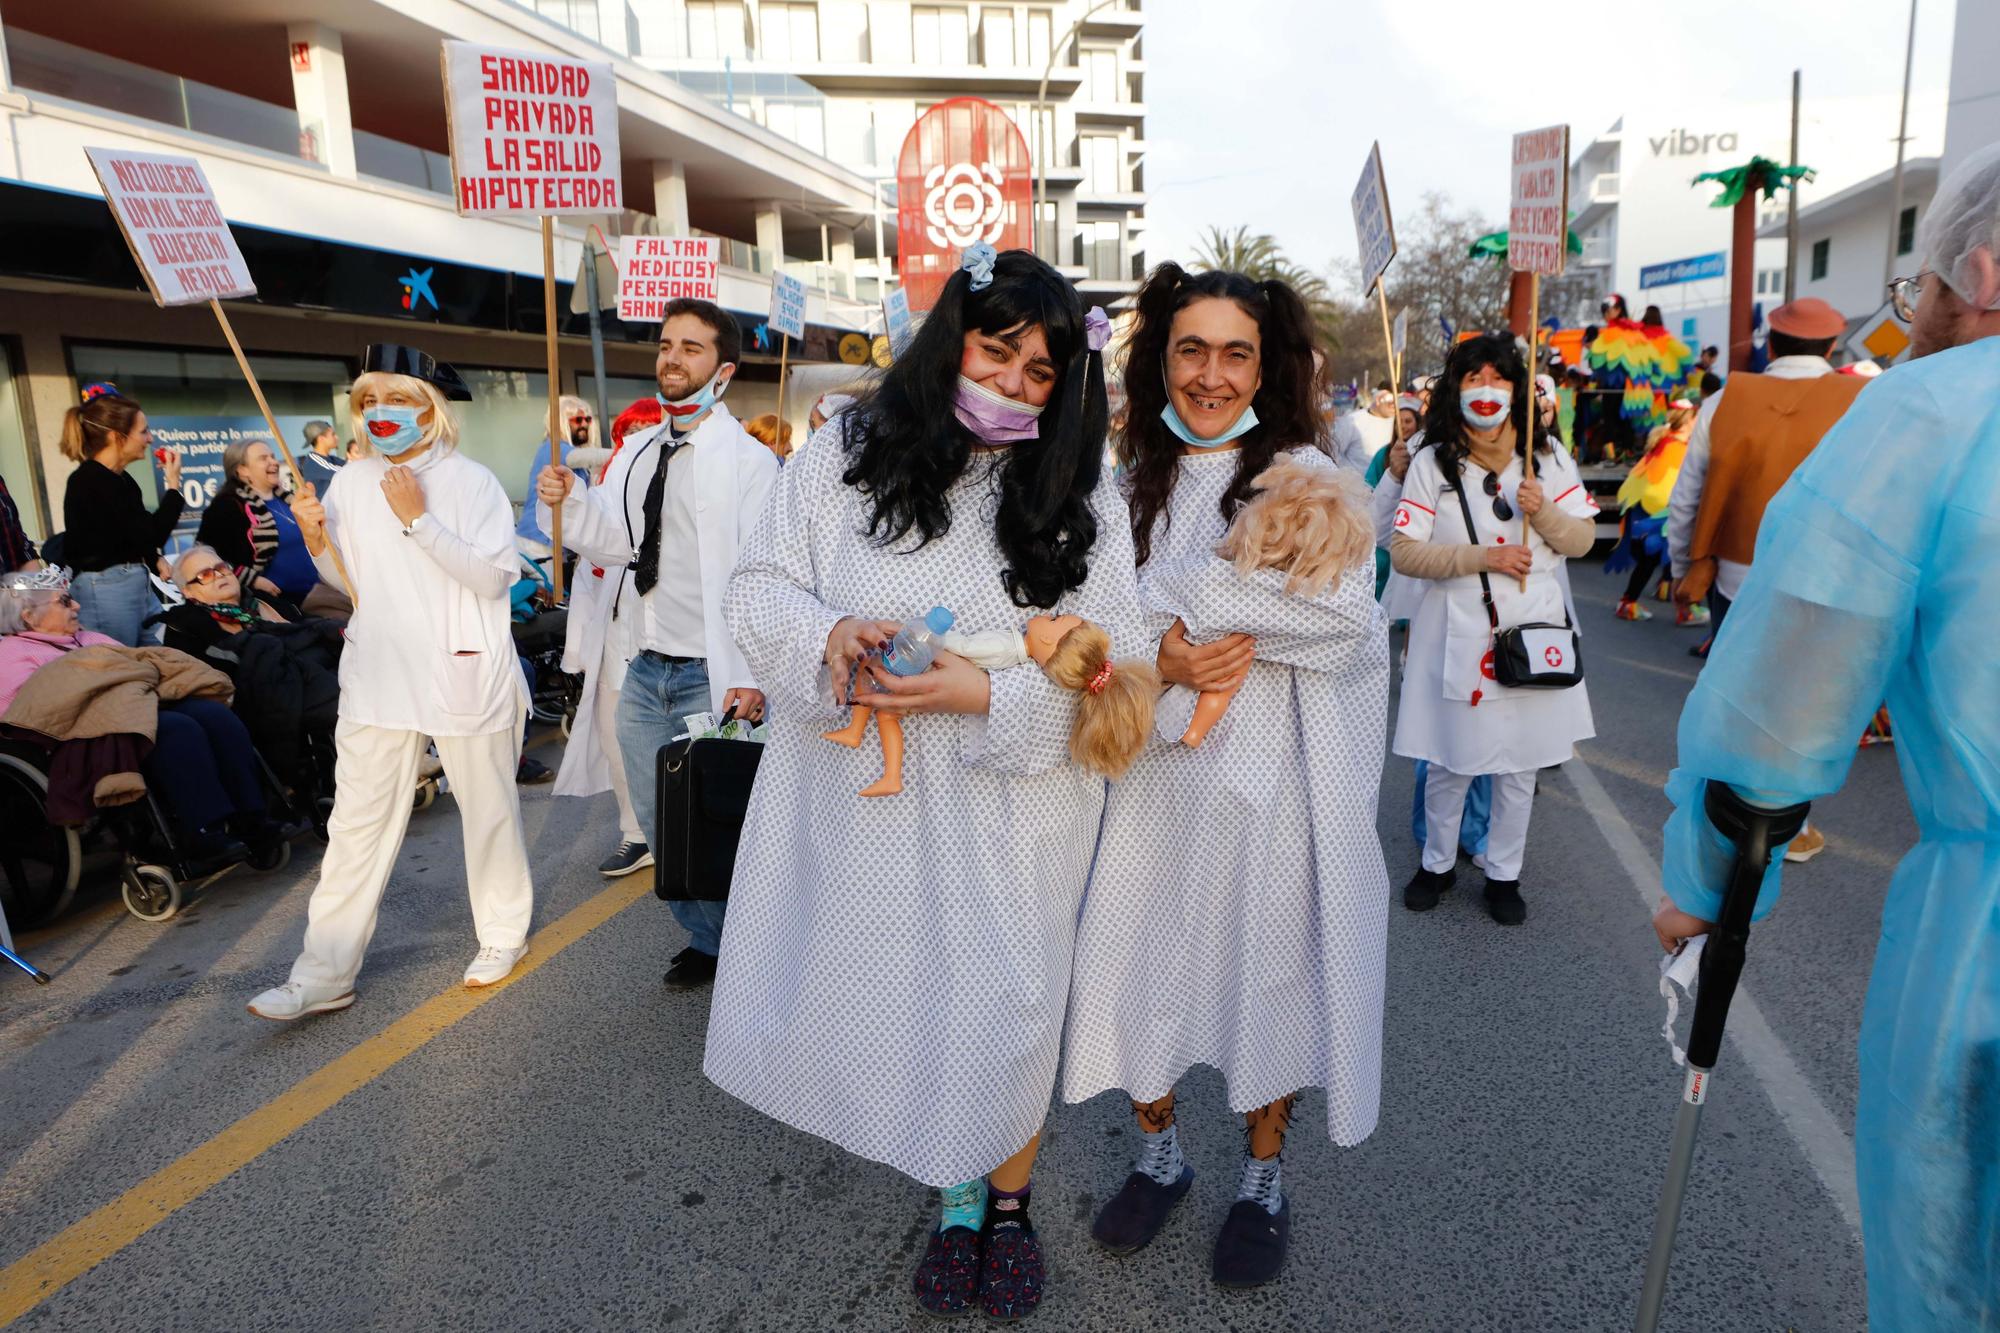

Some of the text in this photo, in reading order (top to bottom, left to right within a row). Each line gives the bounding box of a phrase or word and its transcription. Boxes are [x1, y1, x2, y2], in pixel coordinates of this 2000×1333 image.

[480, 55, 590, 98] SANIDAD
[484, 97, 594, 136] PRIVADA
[525, 140, 602, 172] SALUD
[1648, 128, 1738, 157] vibra
[460, 177, 617, 210] HIPOTECADA
[636, 239, 707, 257] FALTAN
[174, 264, 237, 298] MEDICO
[623, 280, 716, 298] PERSONAL
[199, 431, 219, 440] ver
[220, 431, 228, 440] a
[229, 427, 241, 440] lo
